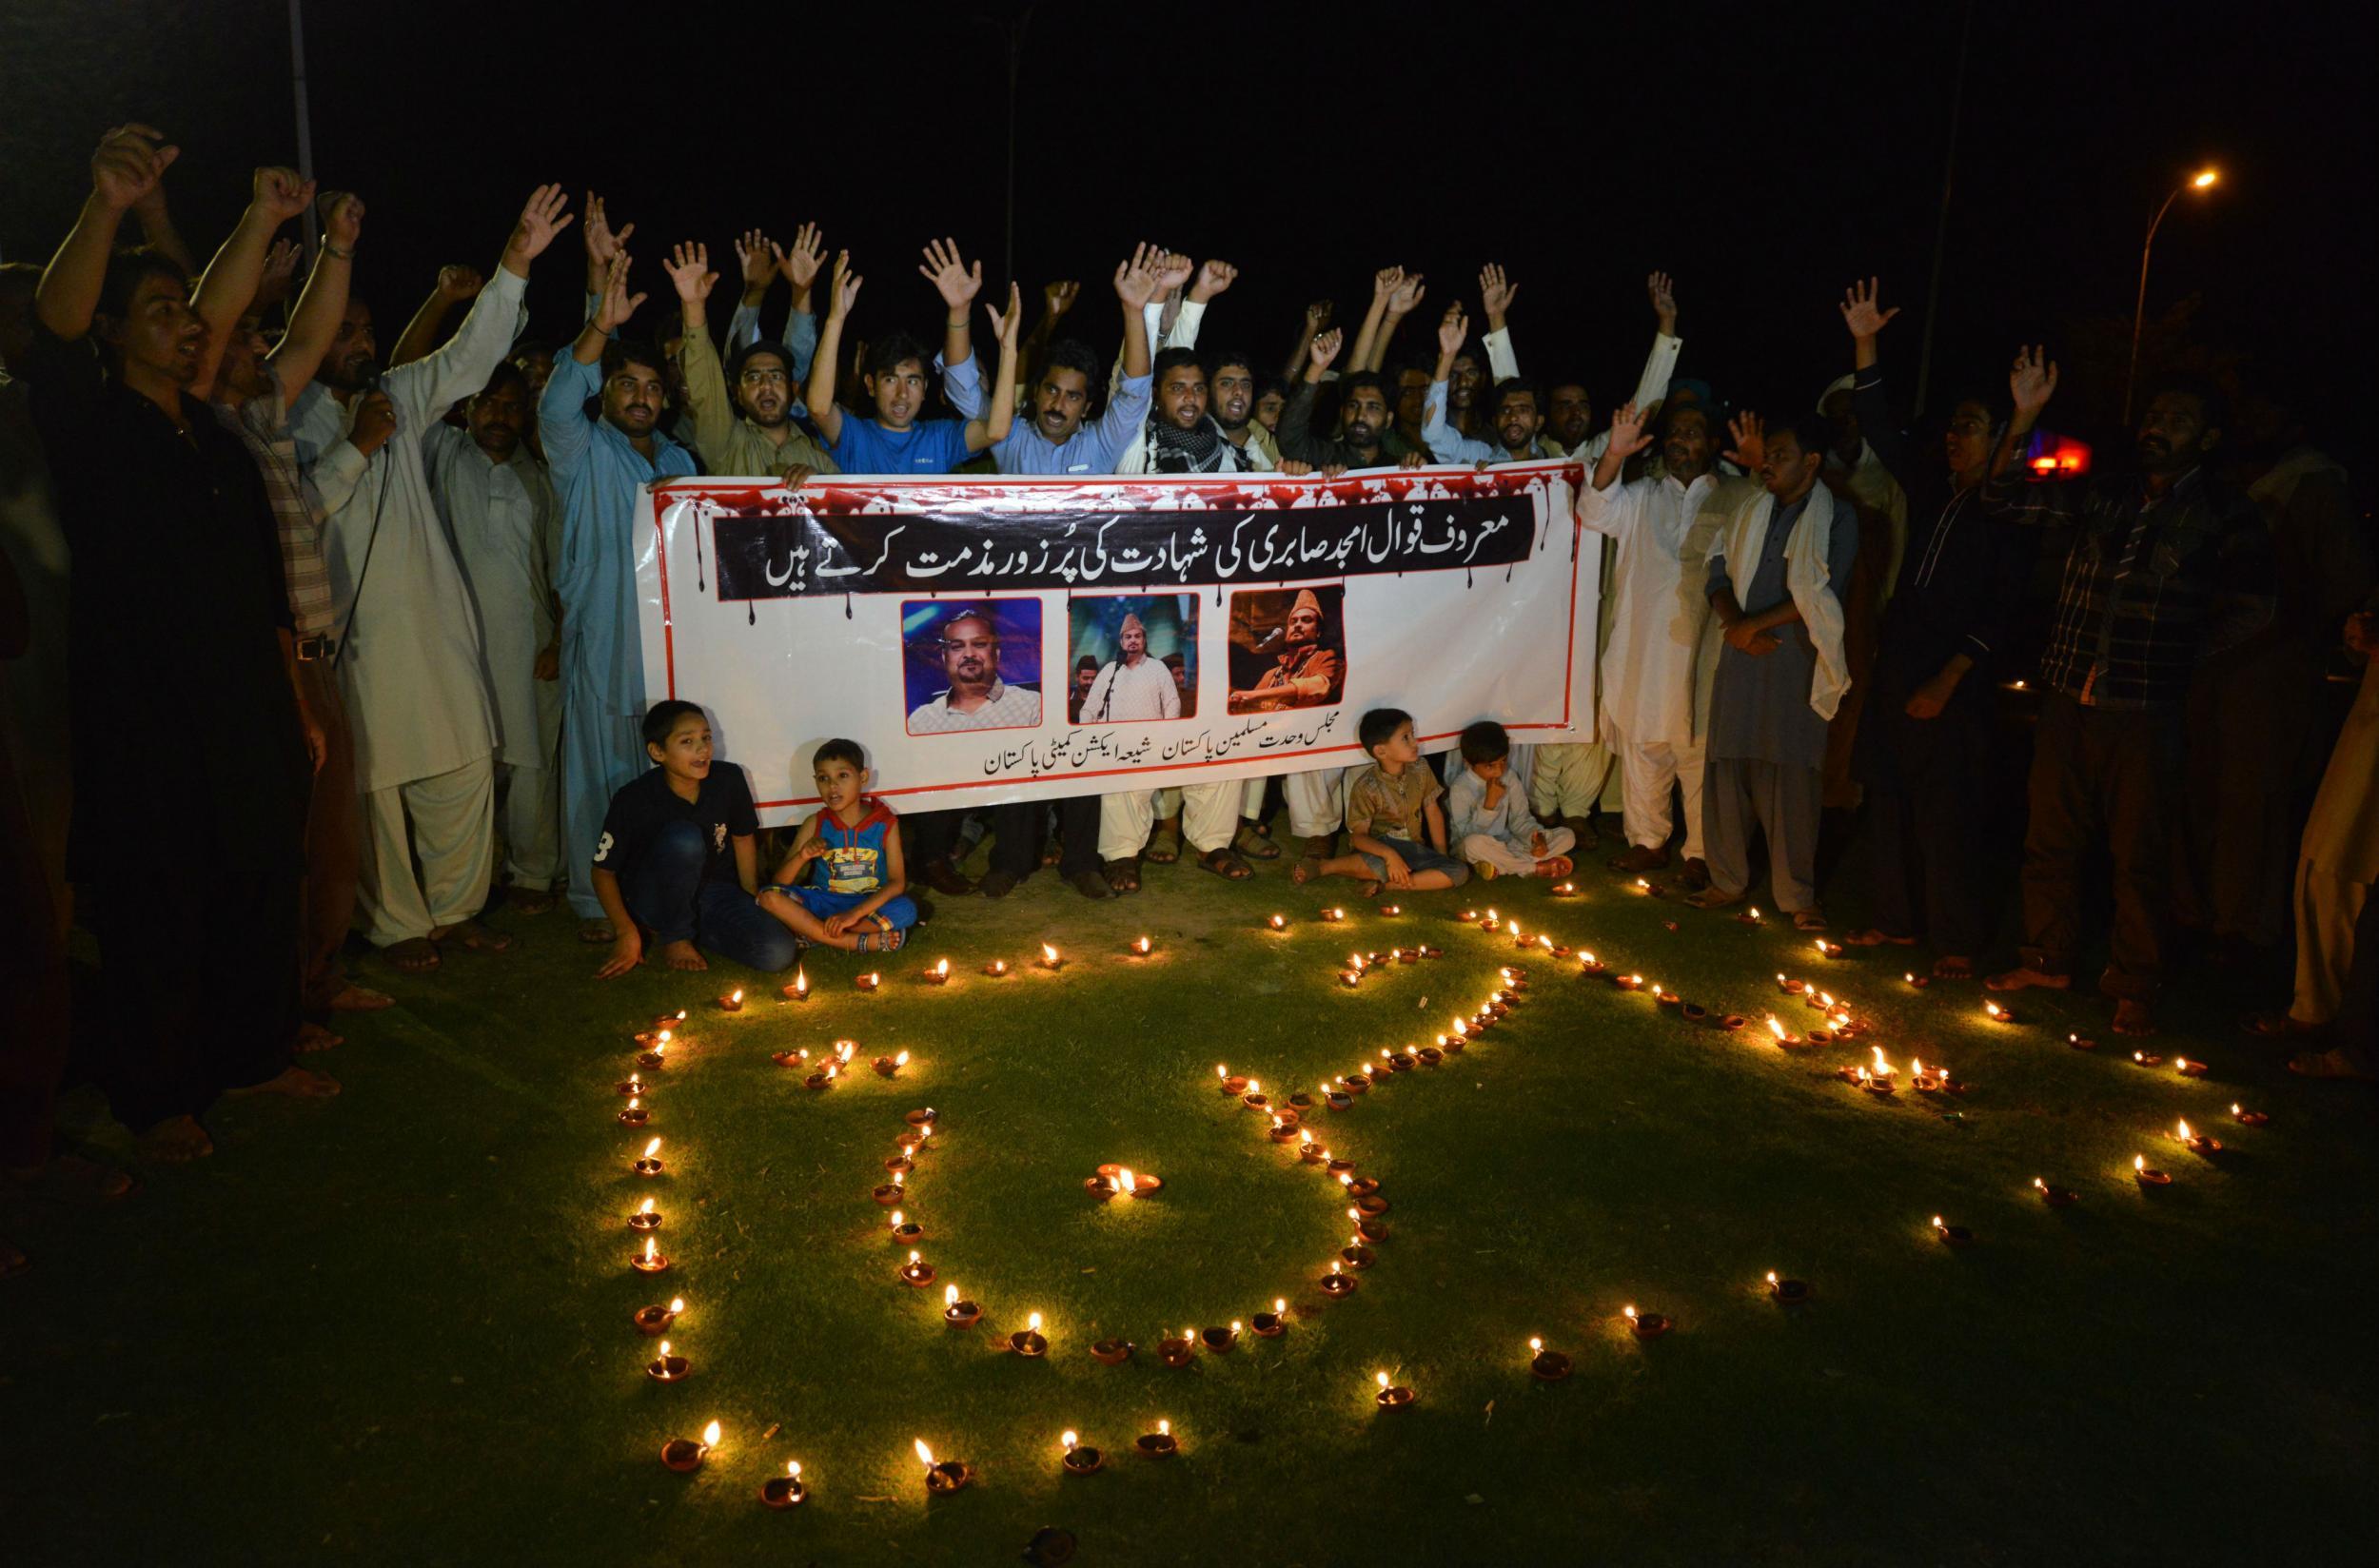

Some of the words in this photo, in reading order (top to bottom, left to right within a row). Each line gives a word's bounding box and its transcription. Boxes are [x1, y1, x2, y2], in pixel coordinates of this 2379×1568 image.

[1080, 515, 1120, 580] کی
[1215, 513, 1255, 578] کی
[1249, 523, 1330, 572] صابری
[1328, 522, 1367, 570] امجد
[1368, 504, 1424, 563] قوال
[1420, 514, 1509, 563] معروف
[765, 544, 810, 592] ہیں
[905, 539, 993, 578] مذمت
[1111, 527, 1208, 583] شہادت
[1162, 729, 1213, 763] پاکستان
[1215, 718, 1268, 756] مسلمین
[1259, 732, 1304, 748] وحدت
[1304, 711, 1340, 746] مجلس
[984, 740, 1039, 778] پاکستان
[1042, 729, 1083, 770] کمیٹی
[1072, 731, 1118, 768] ایکشن
[1116, 736, 1152, 763] شیعہ
